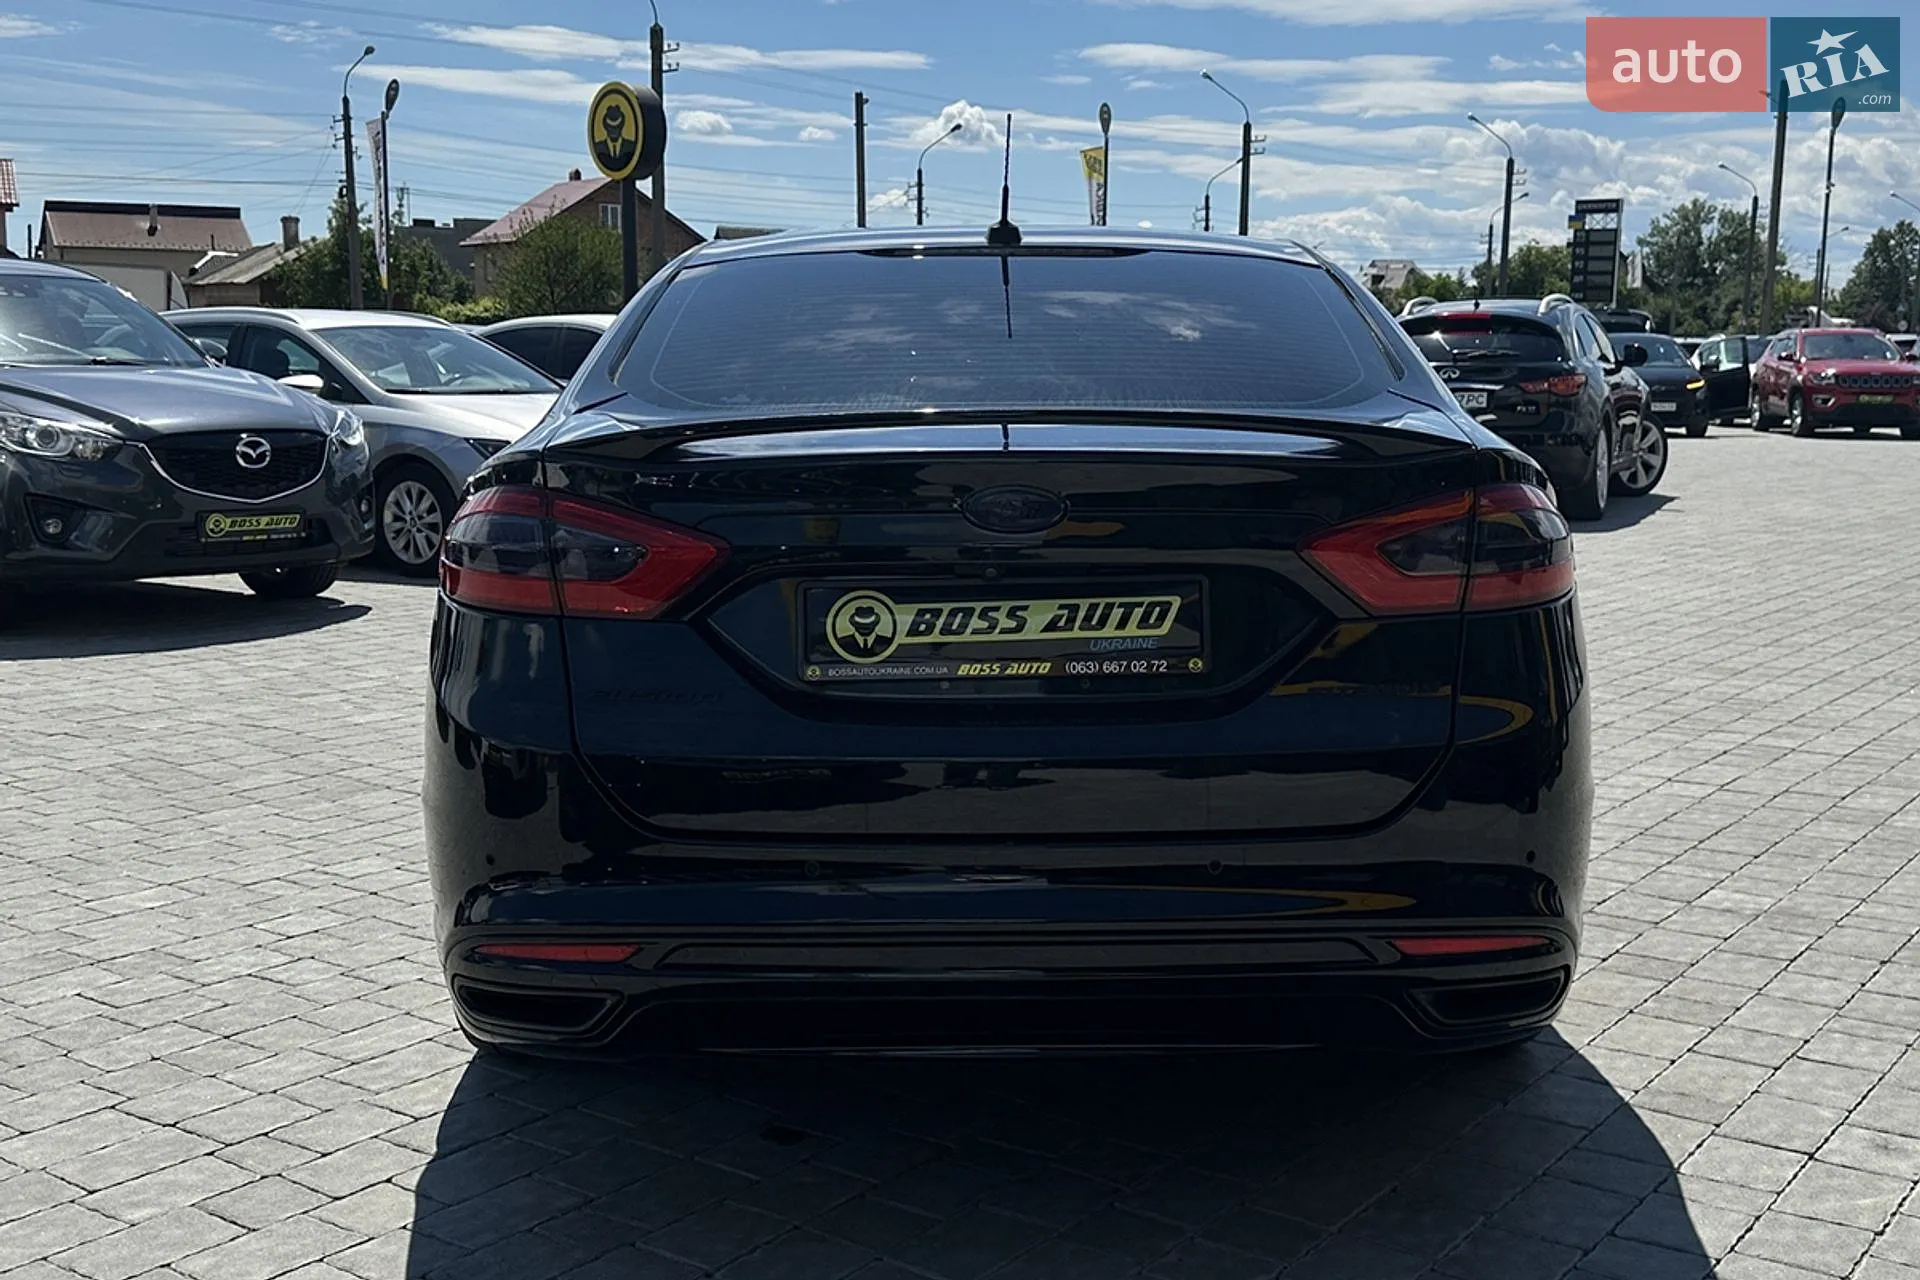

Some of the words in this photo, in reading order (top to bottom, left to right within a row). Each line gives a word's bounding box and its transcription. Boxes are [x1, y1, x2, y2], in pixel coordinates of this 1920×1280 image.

[229, 518, 261, 529] BOSS
[265, 516, 298, 527] AUTO
[905, 604, 1030, 639] BOSS
[1040, 600, 1173, 633] AUTO
[1089, 637, 1160, 651] UKRAINE
[957, 662, 1001, 676] BOSS
[1005, 661, 1053, 675] AUTO
[1065, 660, 1099, 675] (063)
[1103, 660, 1125, 673] 667
[1128, 660, 1150, 673] 02
[1151, 660, 1167, 672] 72
